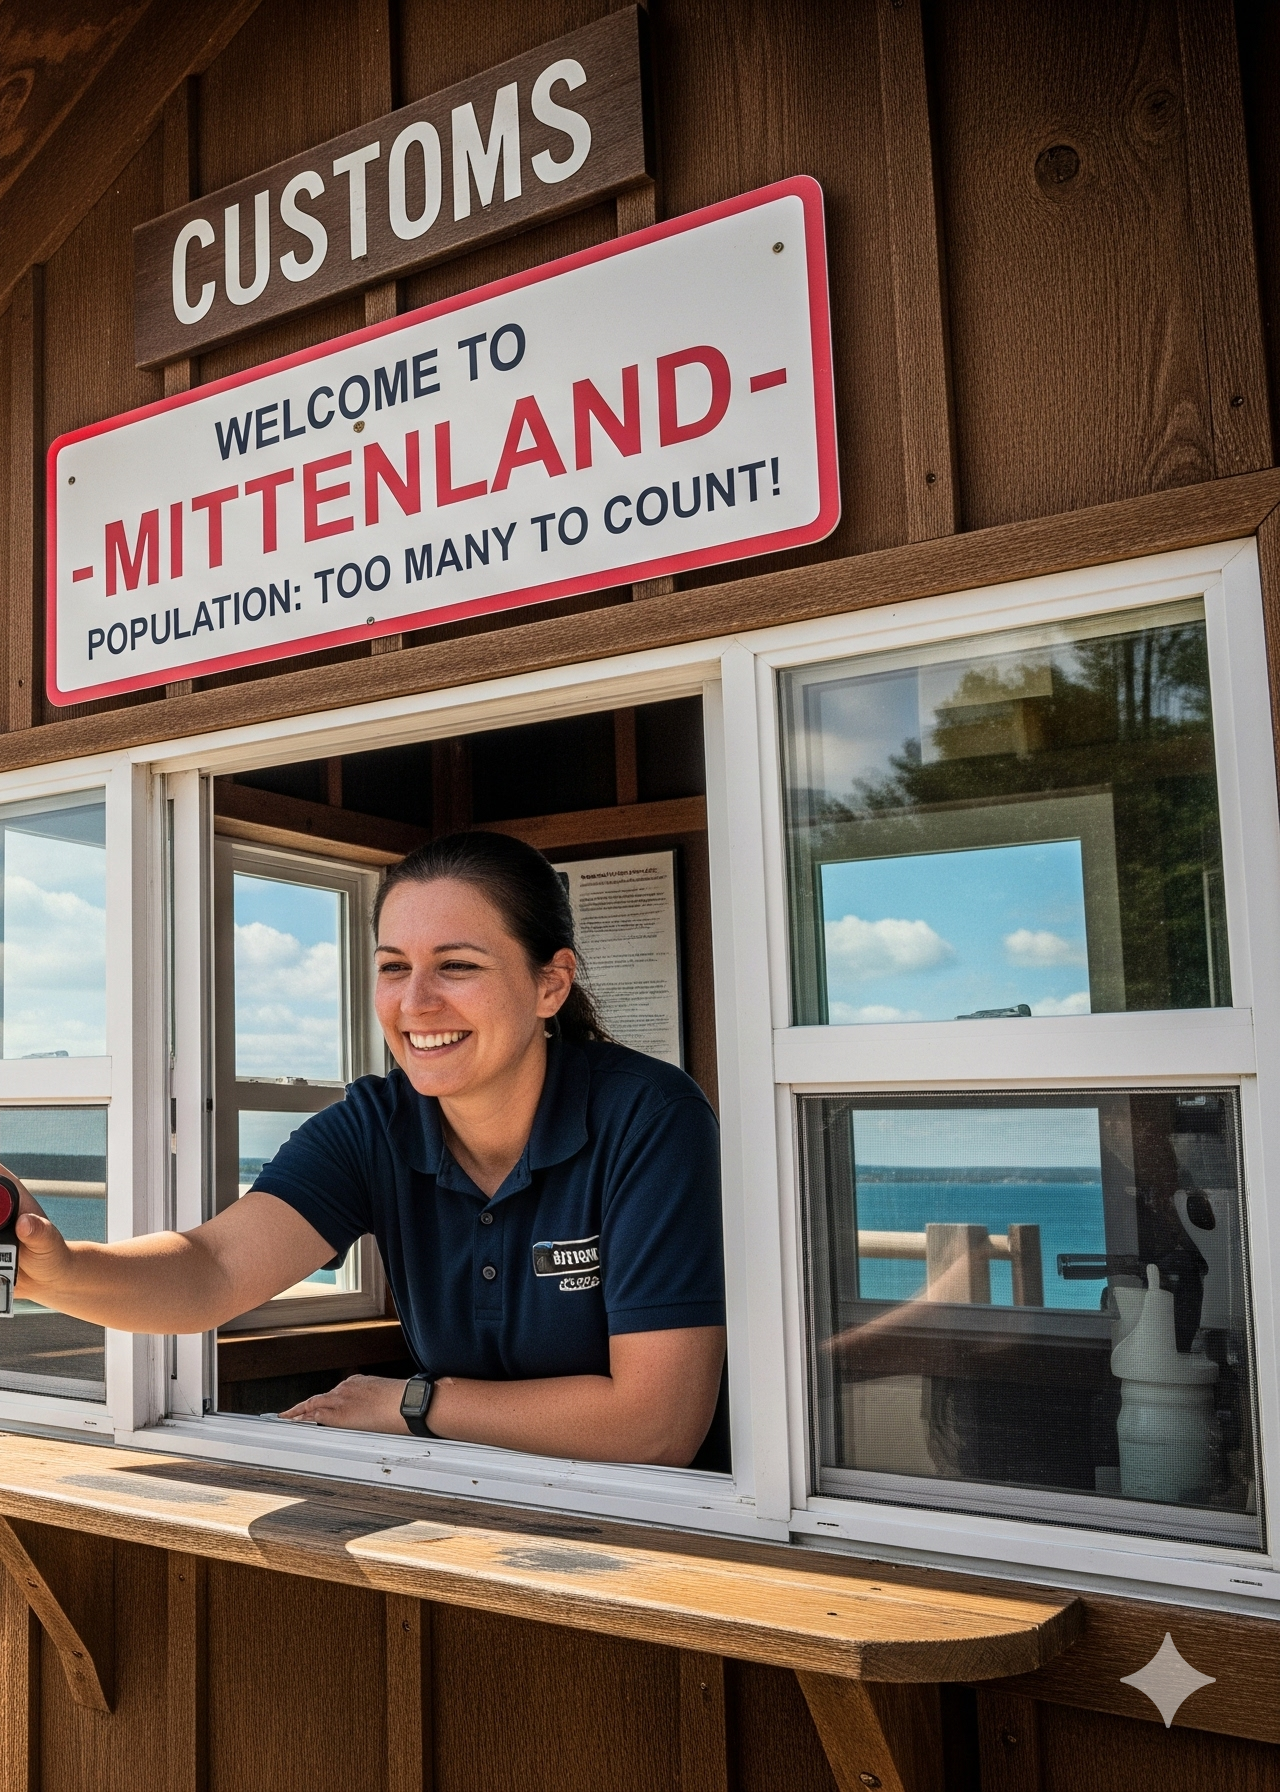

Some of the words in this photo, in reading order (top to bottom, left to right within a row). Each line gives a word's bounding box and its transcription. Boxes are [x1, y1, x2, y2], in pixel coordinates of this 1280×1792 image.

[172, 58, 592, 325] CUSTOMS
[215, 347, 440, 461] WELCOME
[457, 323, 526, 381] TO
[88, 579, 301, 661] POPULATION:
[314, 555, 391, 604] TOO
[405, 522, 517, 583] MANY
[531, 507, 589, 554] TO
[604, 457, 781, 534] COUNT!
